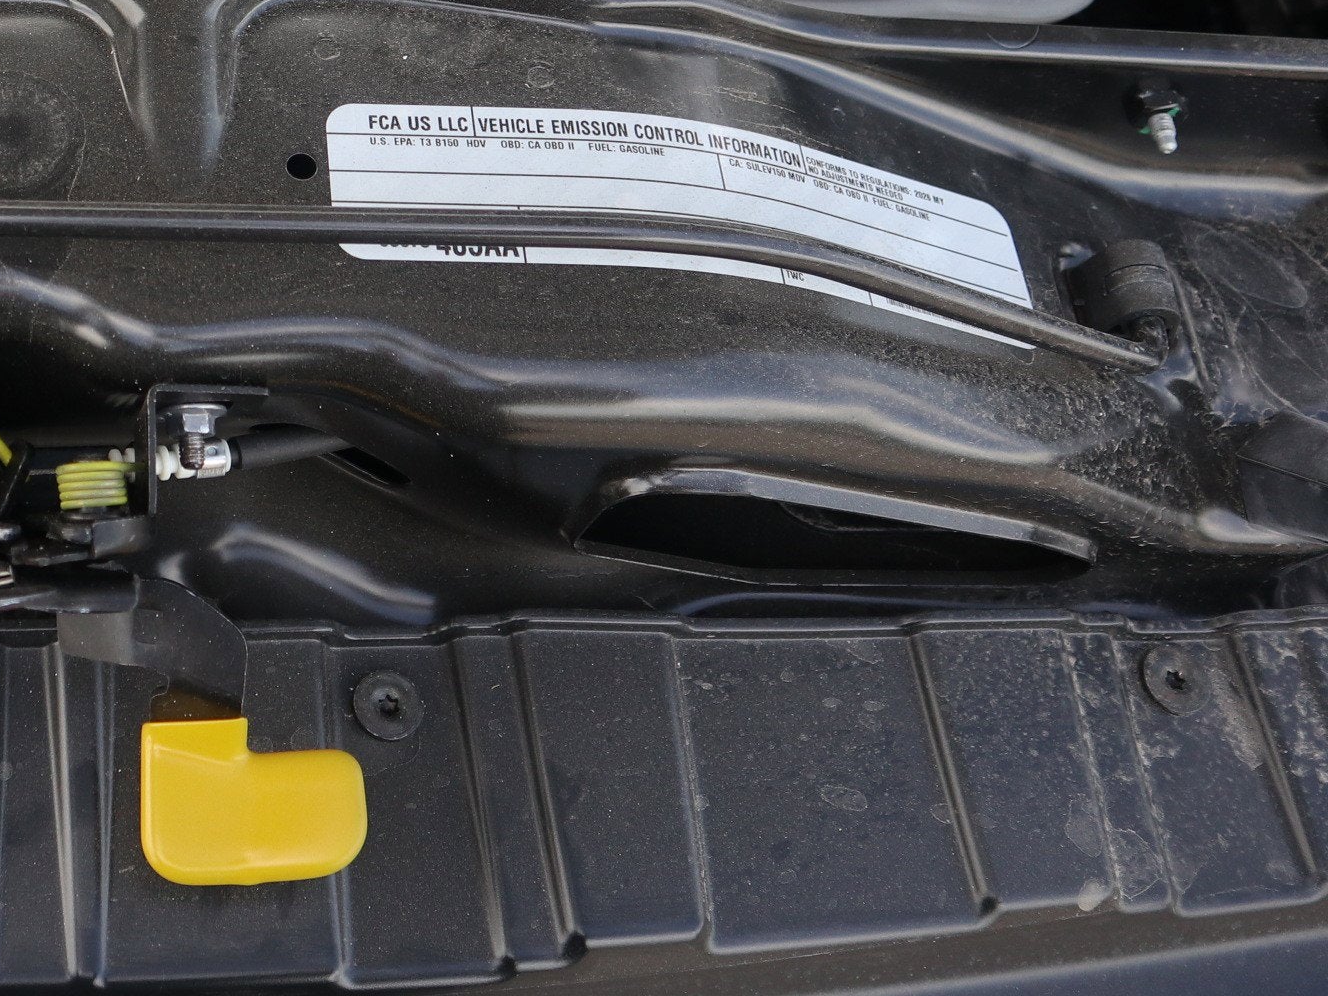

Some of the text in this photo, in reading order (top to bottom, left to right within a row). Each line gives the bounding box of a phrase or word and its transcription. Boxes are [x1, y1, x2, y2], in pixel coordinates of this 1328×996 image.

[368, 114, 468, 132] FCA US LLC
[369, 137, 390, 146] U.S.
[394, 138, 416, 147] EPA:
[466, 139, 486, 148] HDV
[500, 140, 525, 149] OBD:
[528, 141, 541, 150] CA
[544, 142, 565, 151] OBD
[588, 143, 616, 153] FUEL:
[619, 145, 665, 157] GASOLINE
[477, 117, 802, 169] VEHICLE EMISSION CONTROL INFORMATION
[728, 158, 743, 169] CA:
[833, 184, 845, 195] CA
[872, 196, 894, 211] FUEL:
[895, 203, 931, 222] GASOLINE
[805, 156, 847, 176] CONFORMS
[849, 169, 860, 180] TO
[860, 173, 912, 196] REGULATIONS:
[807, 165, 904, 201] NO ADJUSTMENTS NEEDED
